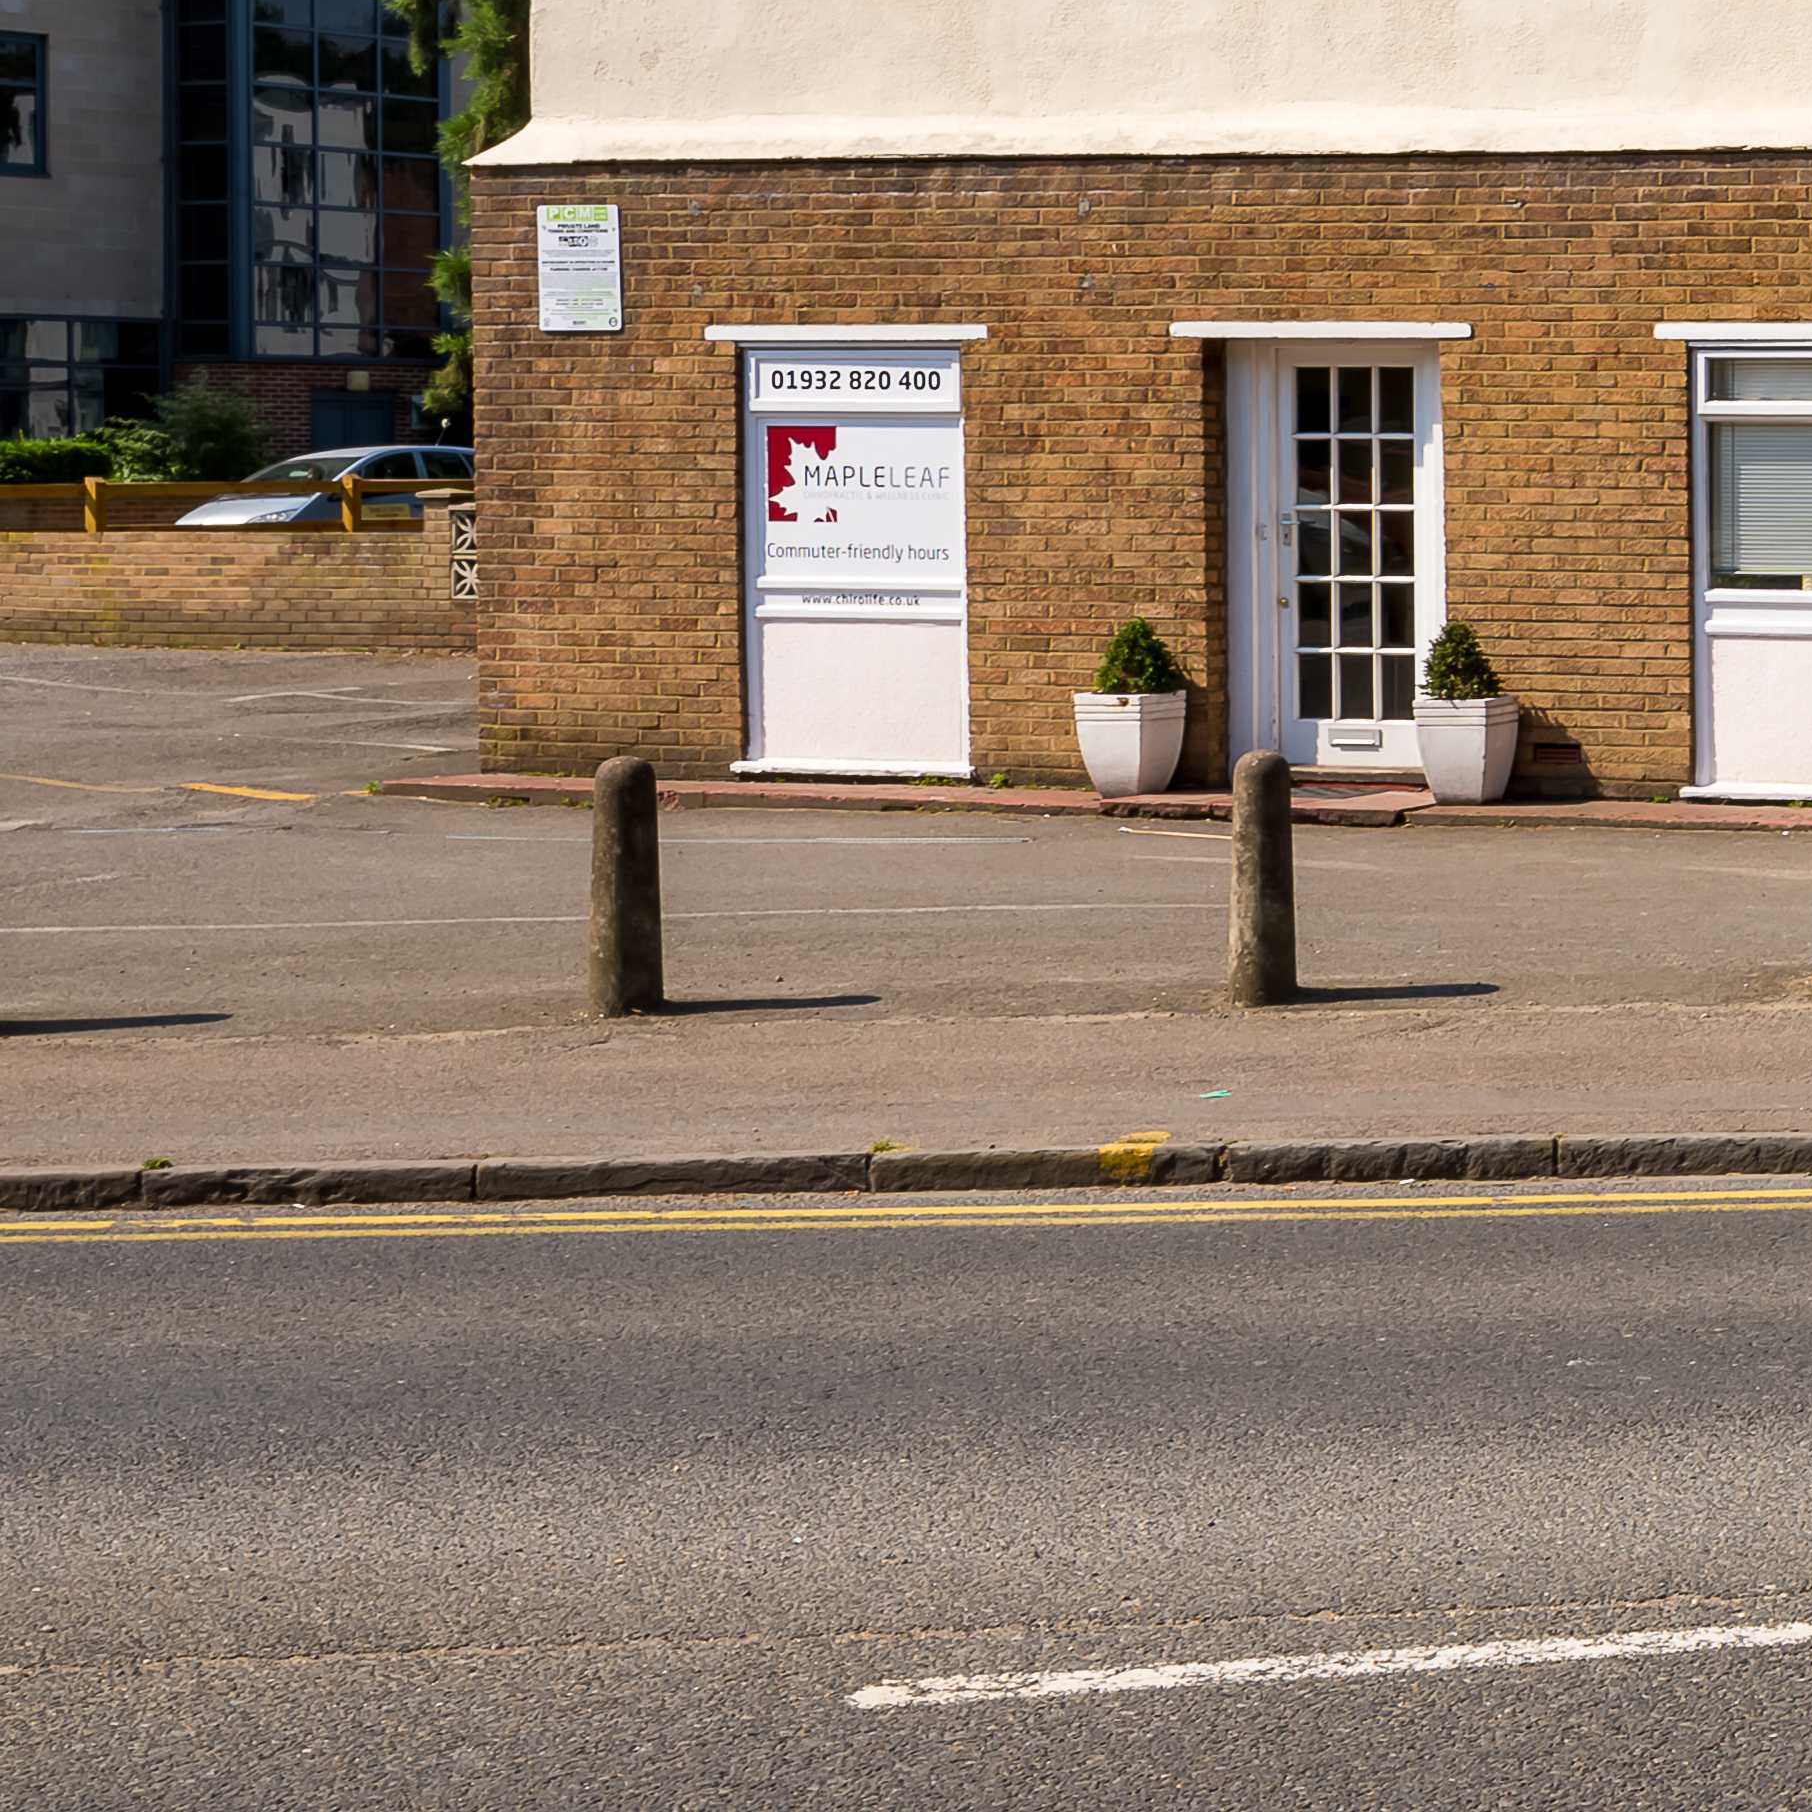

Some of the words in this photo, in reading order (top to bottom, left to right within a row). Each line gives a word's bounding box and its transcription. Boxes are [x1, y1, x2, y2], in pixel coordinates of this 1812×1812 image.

[547, 207, 592, 220] PCM
[771, 370, 841, 390] 01932
[849, 371, 891, 390] 820
[899, 371, 941, 390] 400
[804, 465, 950, 488] MAPLELEAF
[768, 543, 903, 563] Commuter-friendly
[908, 545, 949, 560] hours
[802, 594, 920, 606] www.chirolife.co.uk
